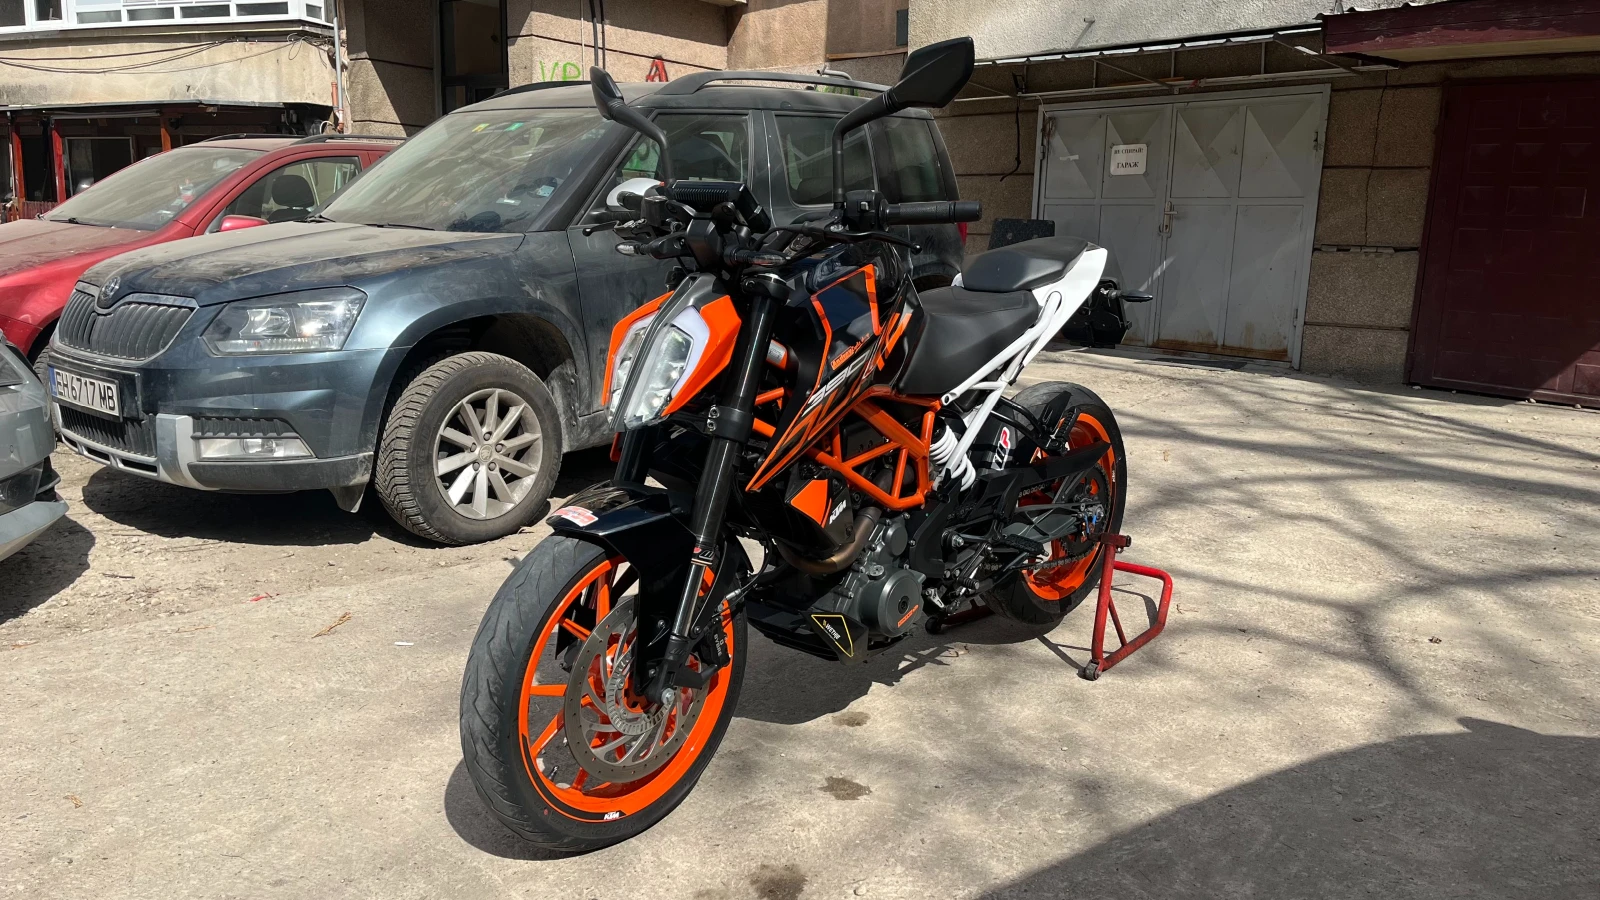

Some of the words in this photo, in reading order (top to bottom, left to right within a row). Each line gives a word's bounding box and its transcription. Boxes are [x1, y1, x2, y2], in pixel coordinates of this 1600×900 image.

[55, 371, 71, 399] EH
[71, 376, 96, 406] 6717
[98, 382, 116, 412] MB
[801, 350, 870, 418] 390
[829, 499, 847, 525] KTM
[603, 811, 620, 821] KTM
